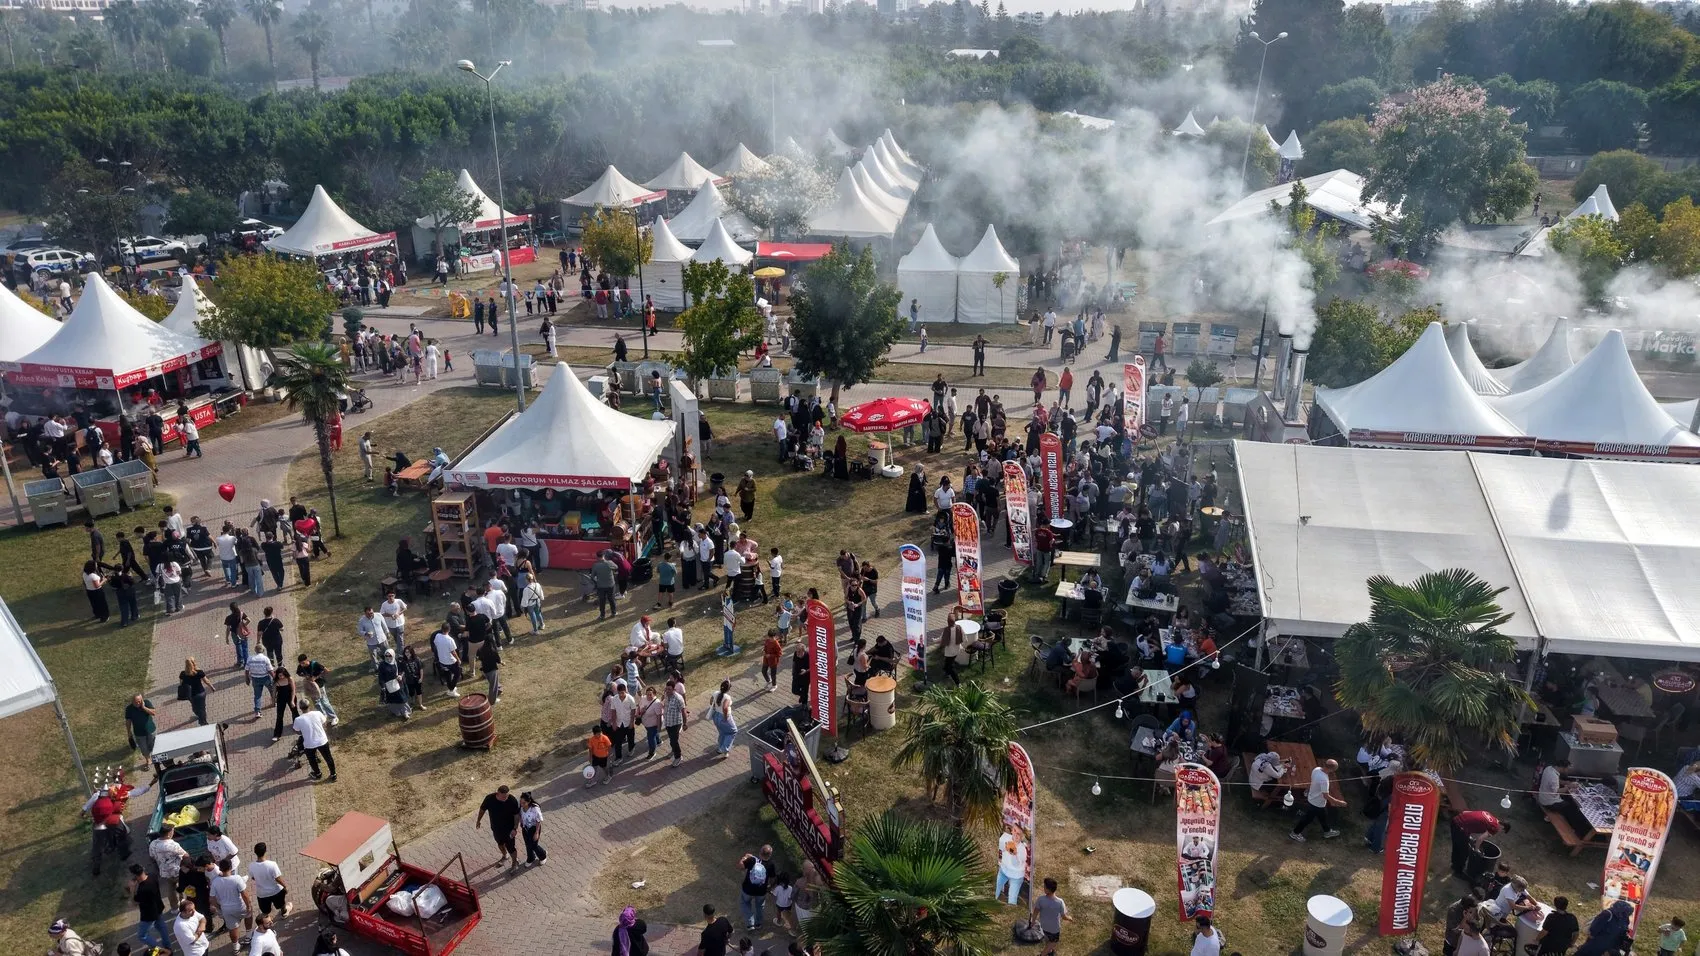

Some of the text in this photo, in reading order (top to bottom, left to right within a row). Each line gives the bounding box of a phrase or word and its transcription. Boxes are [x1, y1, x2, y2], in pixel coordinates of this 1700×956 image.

[1645, 340, 1696, 354] Marka
[194, 410, 211, 421] USTA
[1403, 432, 1477, 446] KABURGACI YAŞAR
[1593, 442, 1670, 456] KABURGACI YAŞAR
[499, 475, 618, 488] DOKTORUM YILMAZ ŞALGAMI
